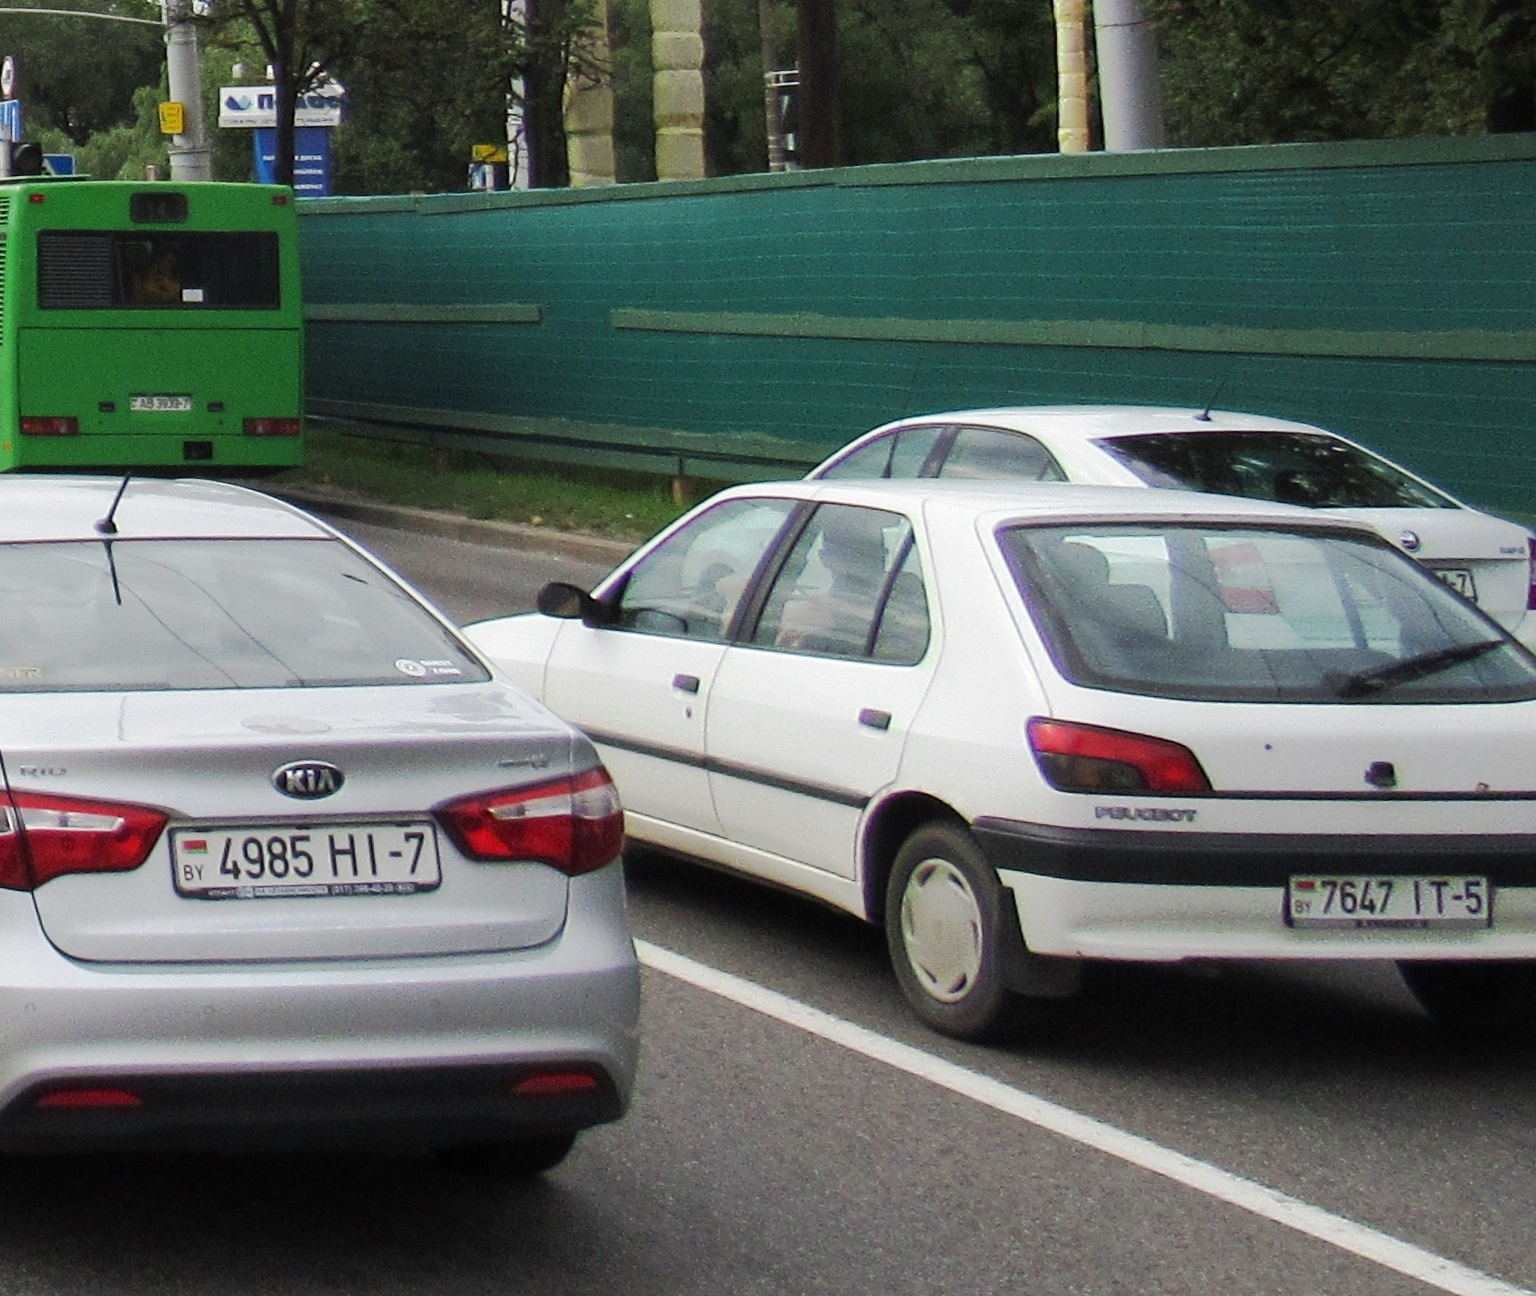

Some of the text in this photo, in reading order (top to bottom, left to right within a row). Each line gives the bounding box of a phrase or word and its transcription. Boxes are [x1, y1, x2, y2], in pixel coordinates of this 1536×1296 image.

[285, 768, 336, 793] KIA
[1094, 806, 1197, 823] PEUGEOT
[219, 835, 314, 880] 4985
[183, 864, 204, 882] BY
[1321, 880, 1393, 915] 7647
